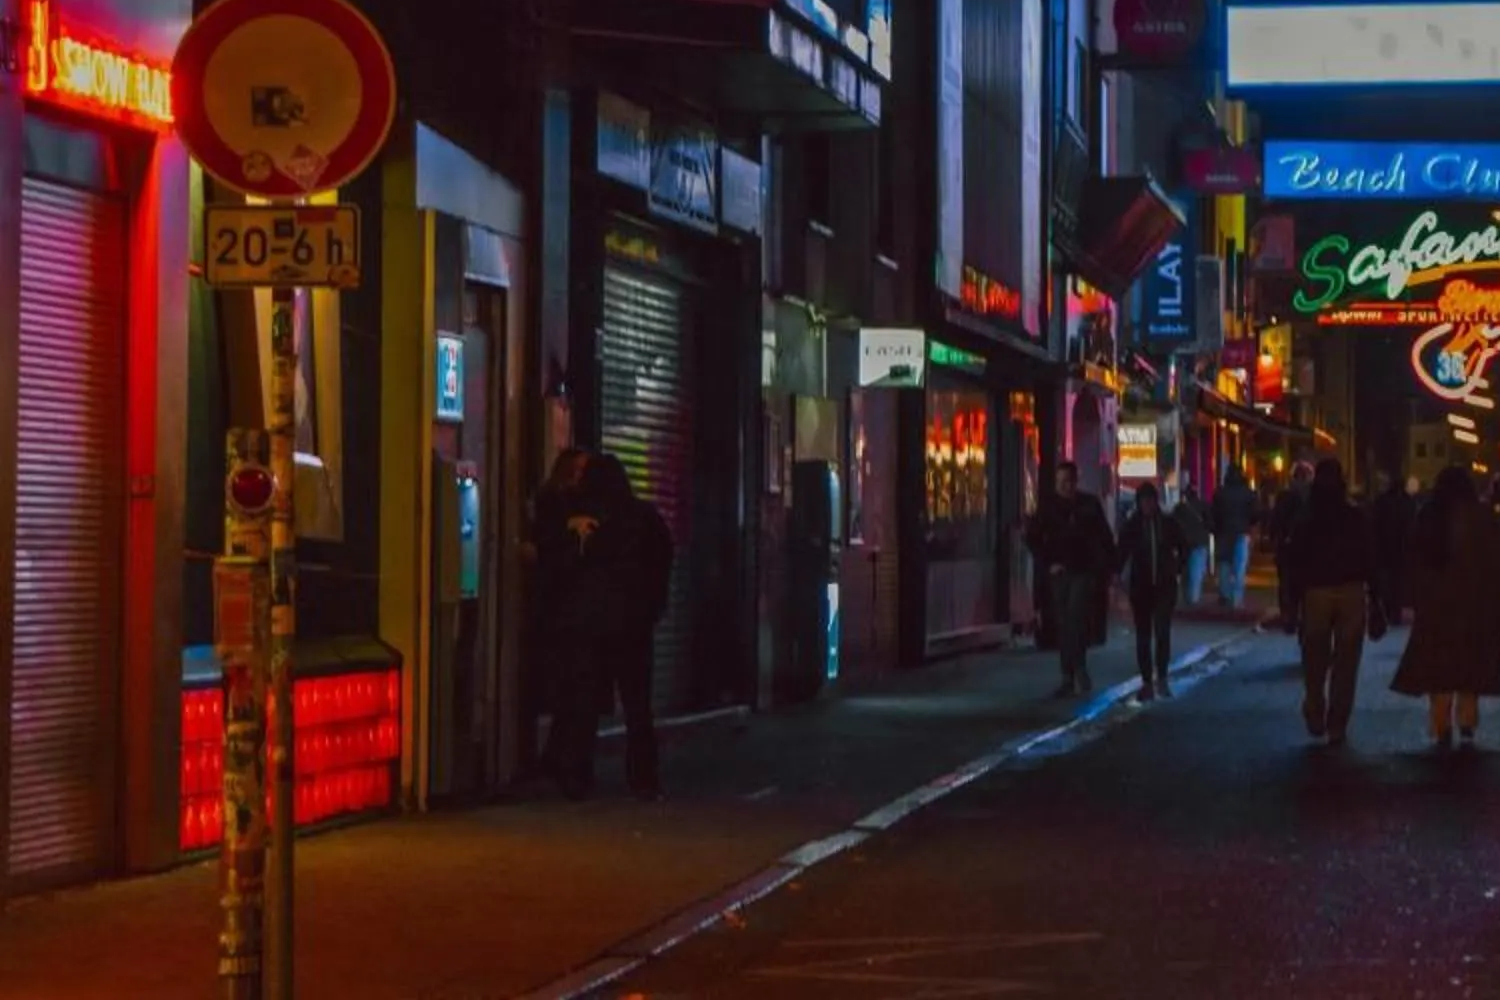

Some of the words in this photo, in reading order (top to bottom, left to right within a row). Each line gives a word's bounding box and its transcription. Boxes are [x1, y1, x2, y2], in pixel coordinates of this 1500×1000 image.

[1279, 152, 1405, 193] Beach
[215, 227, 314, 266] 20-6
[326, 227, 343, 266] h
